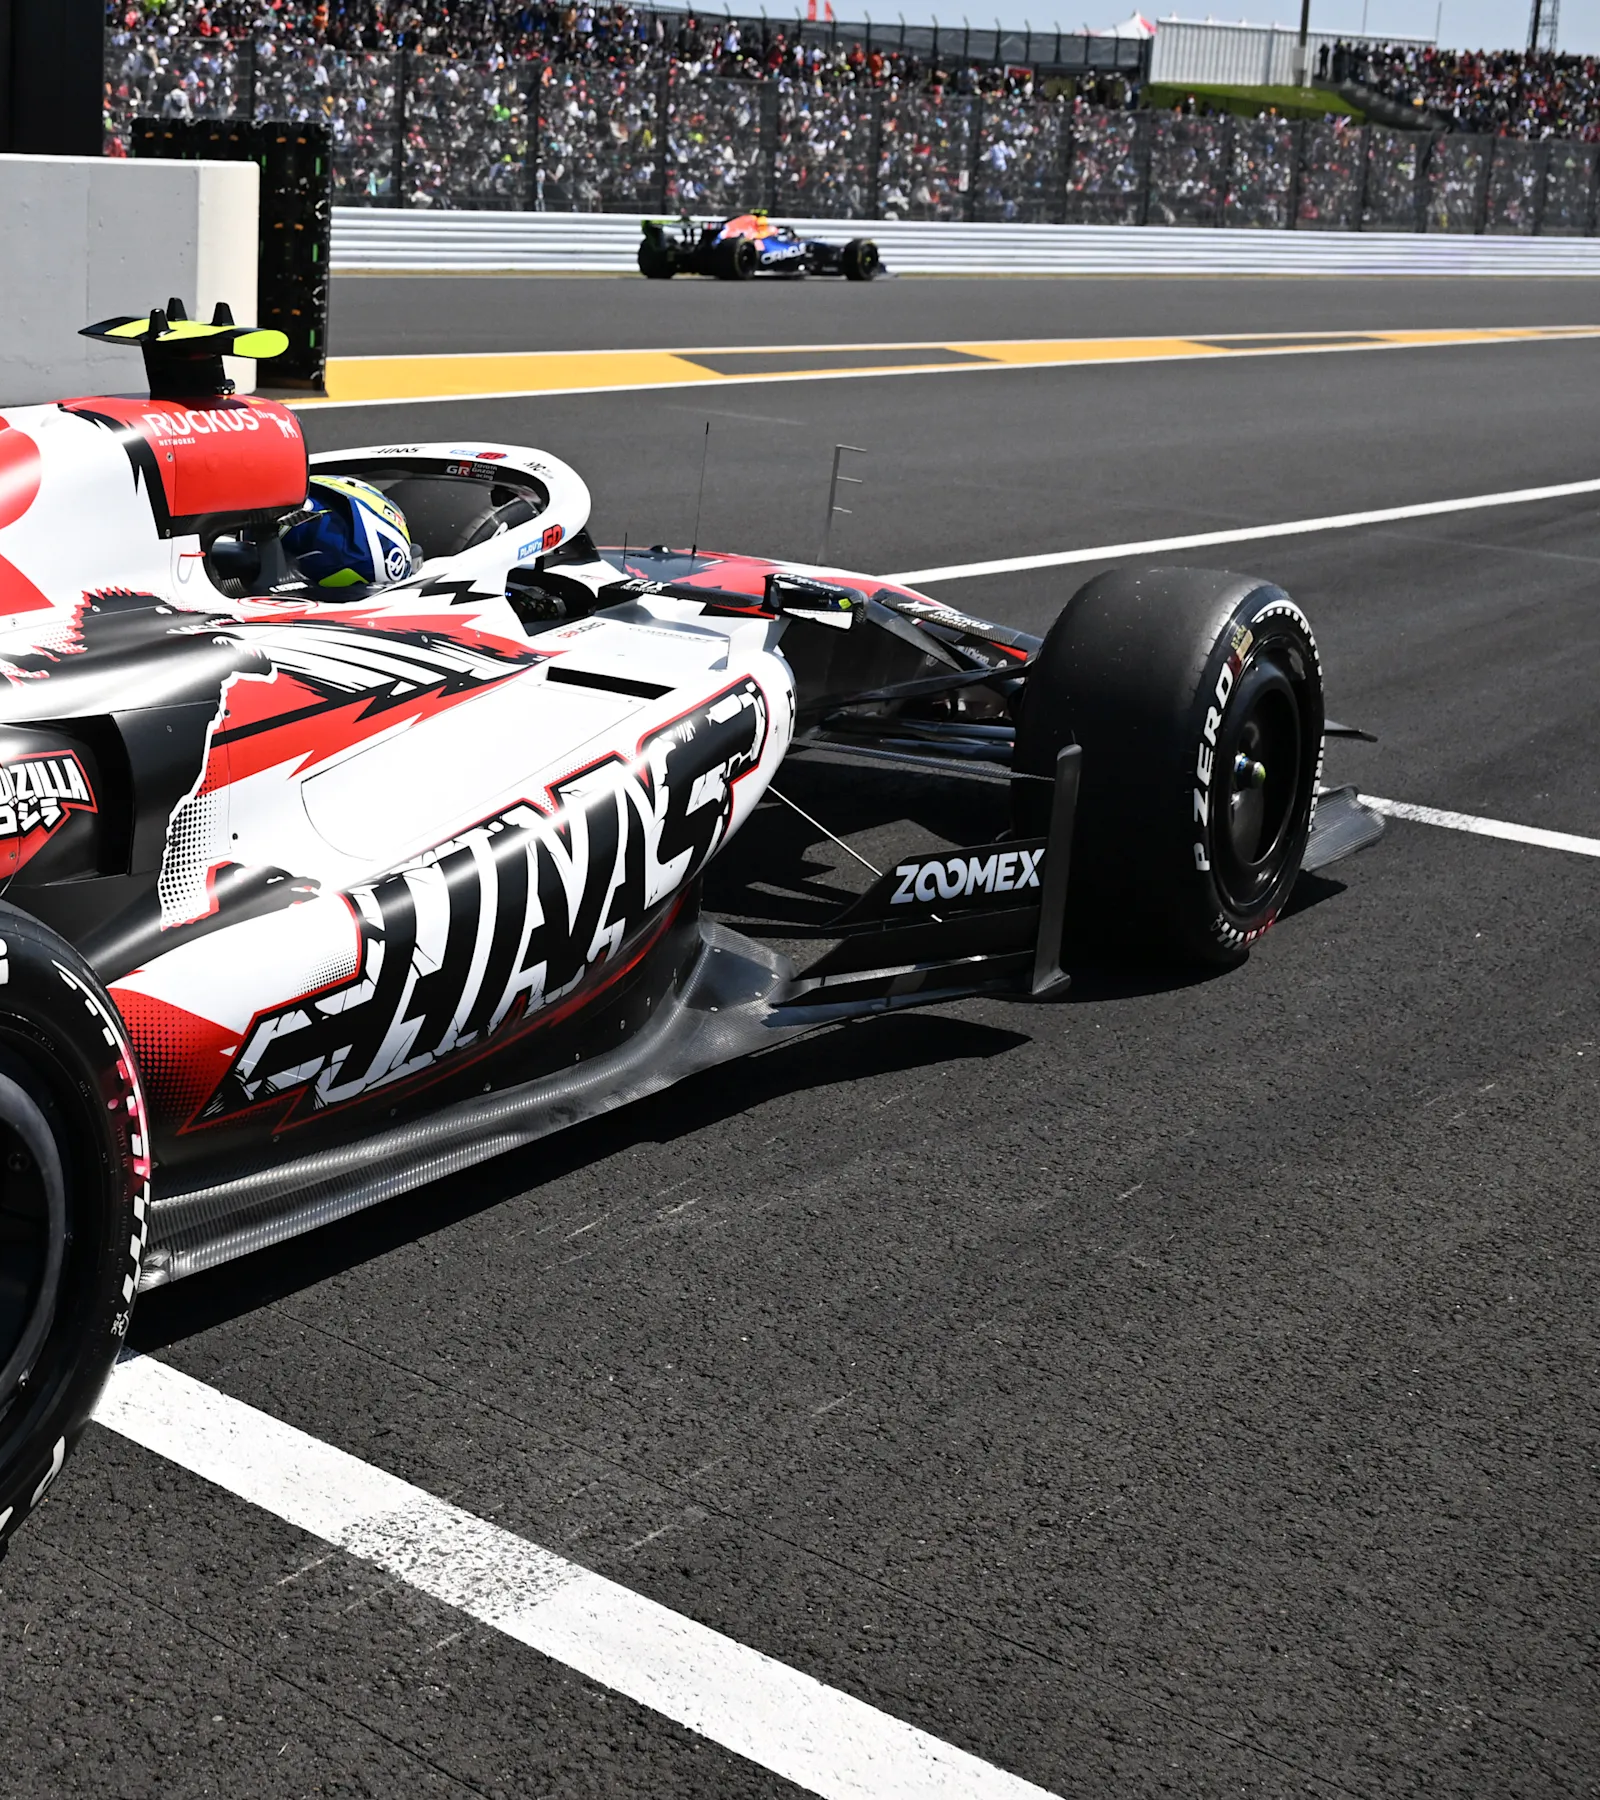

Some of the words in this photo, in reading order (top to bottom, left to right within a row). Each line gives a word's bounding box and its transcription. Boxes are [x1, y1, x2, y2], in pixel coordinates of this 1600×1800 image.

[141, 408, 260, 437] RUCKUS
[158, 437, 196, 447] NETWORKS
[446, 465, 471, 477] GR
[471, 467, 496, 476] GAZOO
[473, 462, 498, 471] TOYOTA
[542, 525, 563, 550] GO
[627, 578, 672, 591] FIX
[935, 611, 993, 630] RUCKUS
[1193, 662, 1234, 827] ZERO
[1193, 842, 1211, 871] P
[889, 848, 1046, 905] ZOOMEX
[30, 1435, 66, 1509] P
